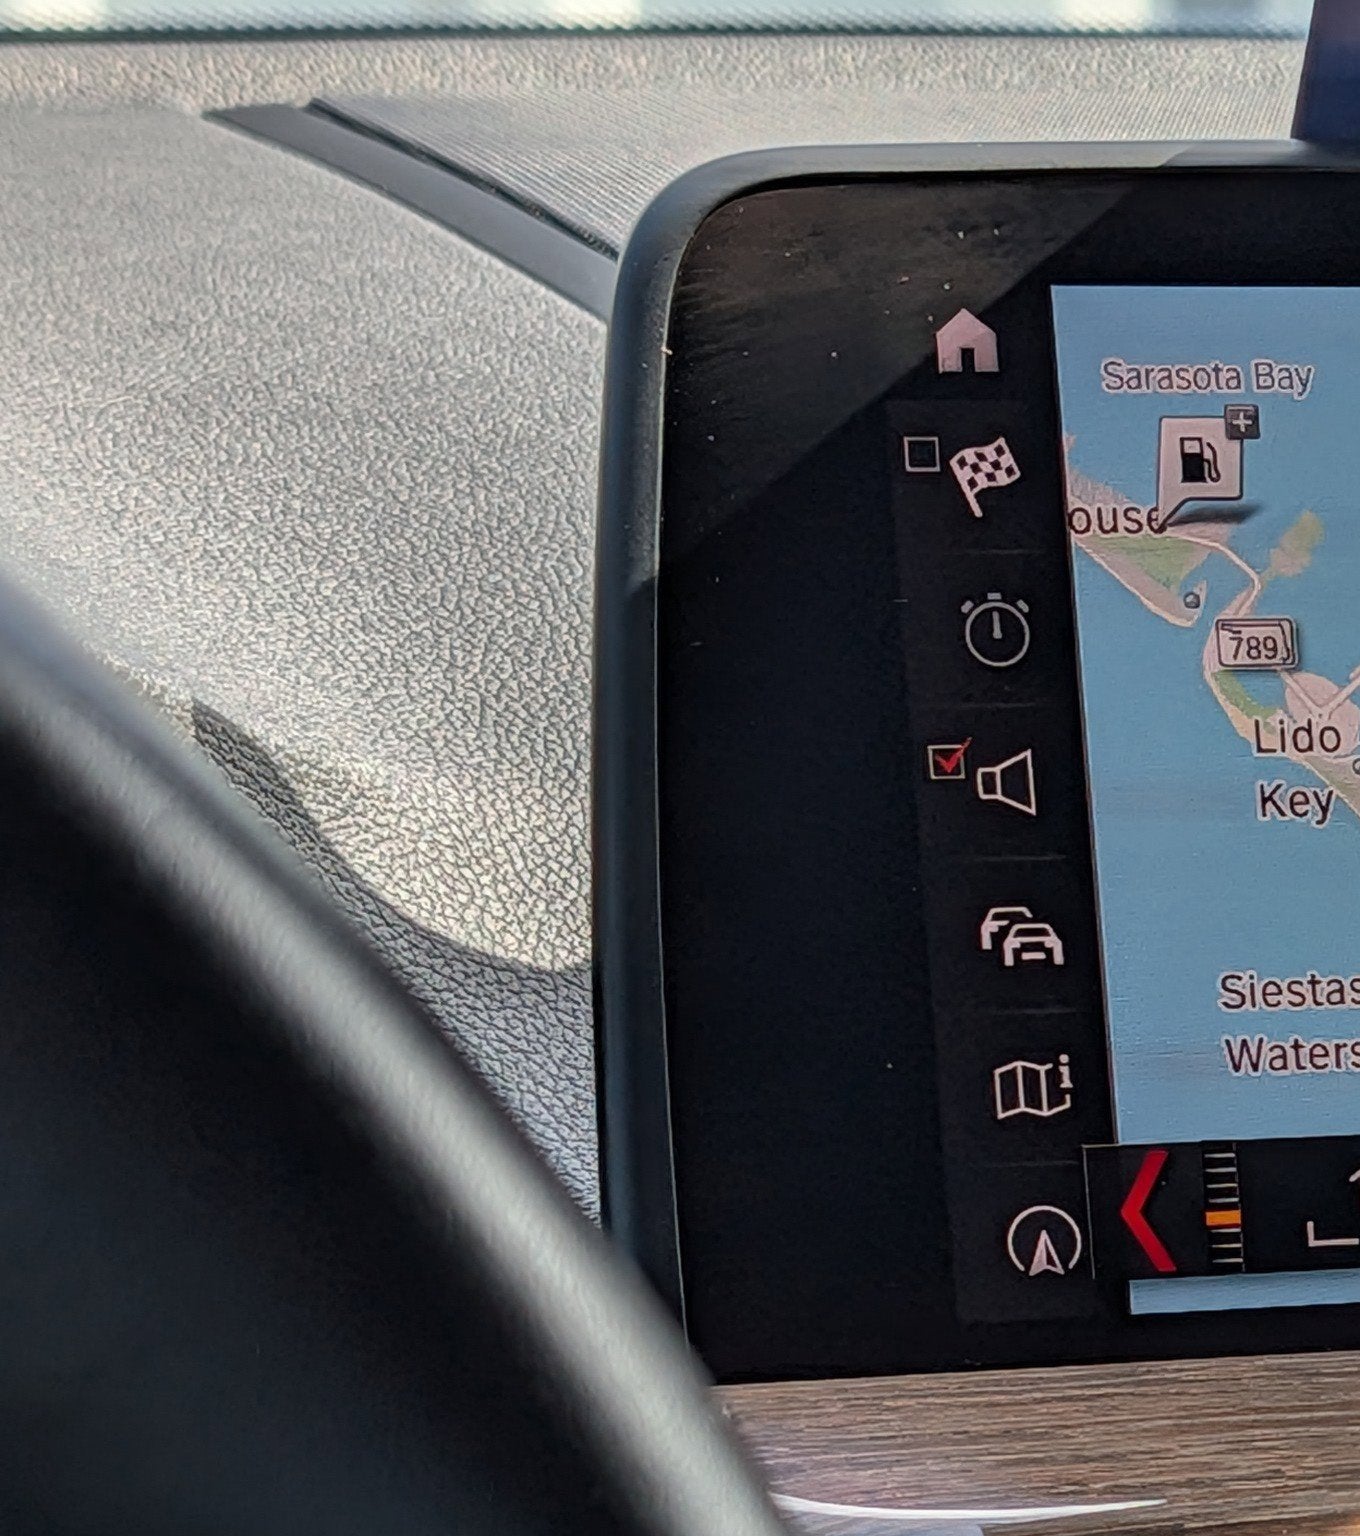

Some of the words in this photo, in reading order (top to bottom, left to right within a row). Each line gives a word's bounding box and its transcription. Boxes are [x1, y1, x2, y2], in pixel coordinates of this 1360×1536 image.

[1102, 362, 1241, 391] Sarasota
[1253, 361, 1312, 394] Bay
[1230, 638, 1278, 660] 789
[1255, 720, 1341, 753] Lido
[1260, 786, 1334, 822] Key
